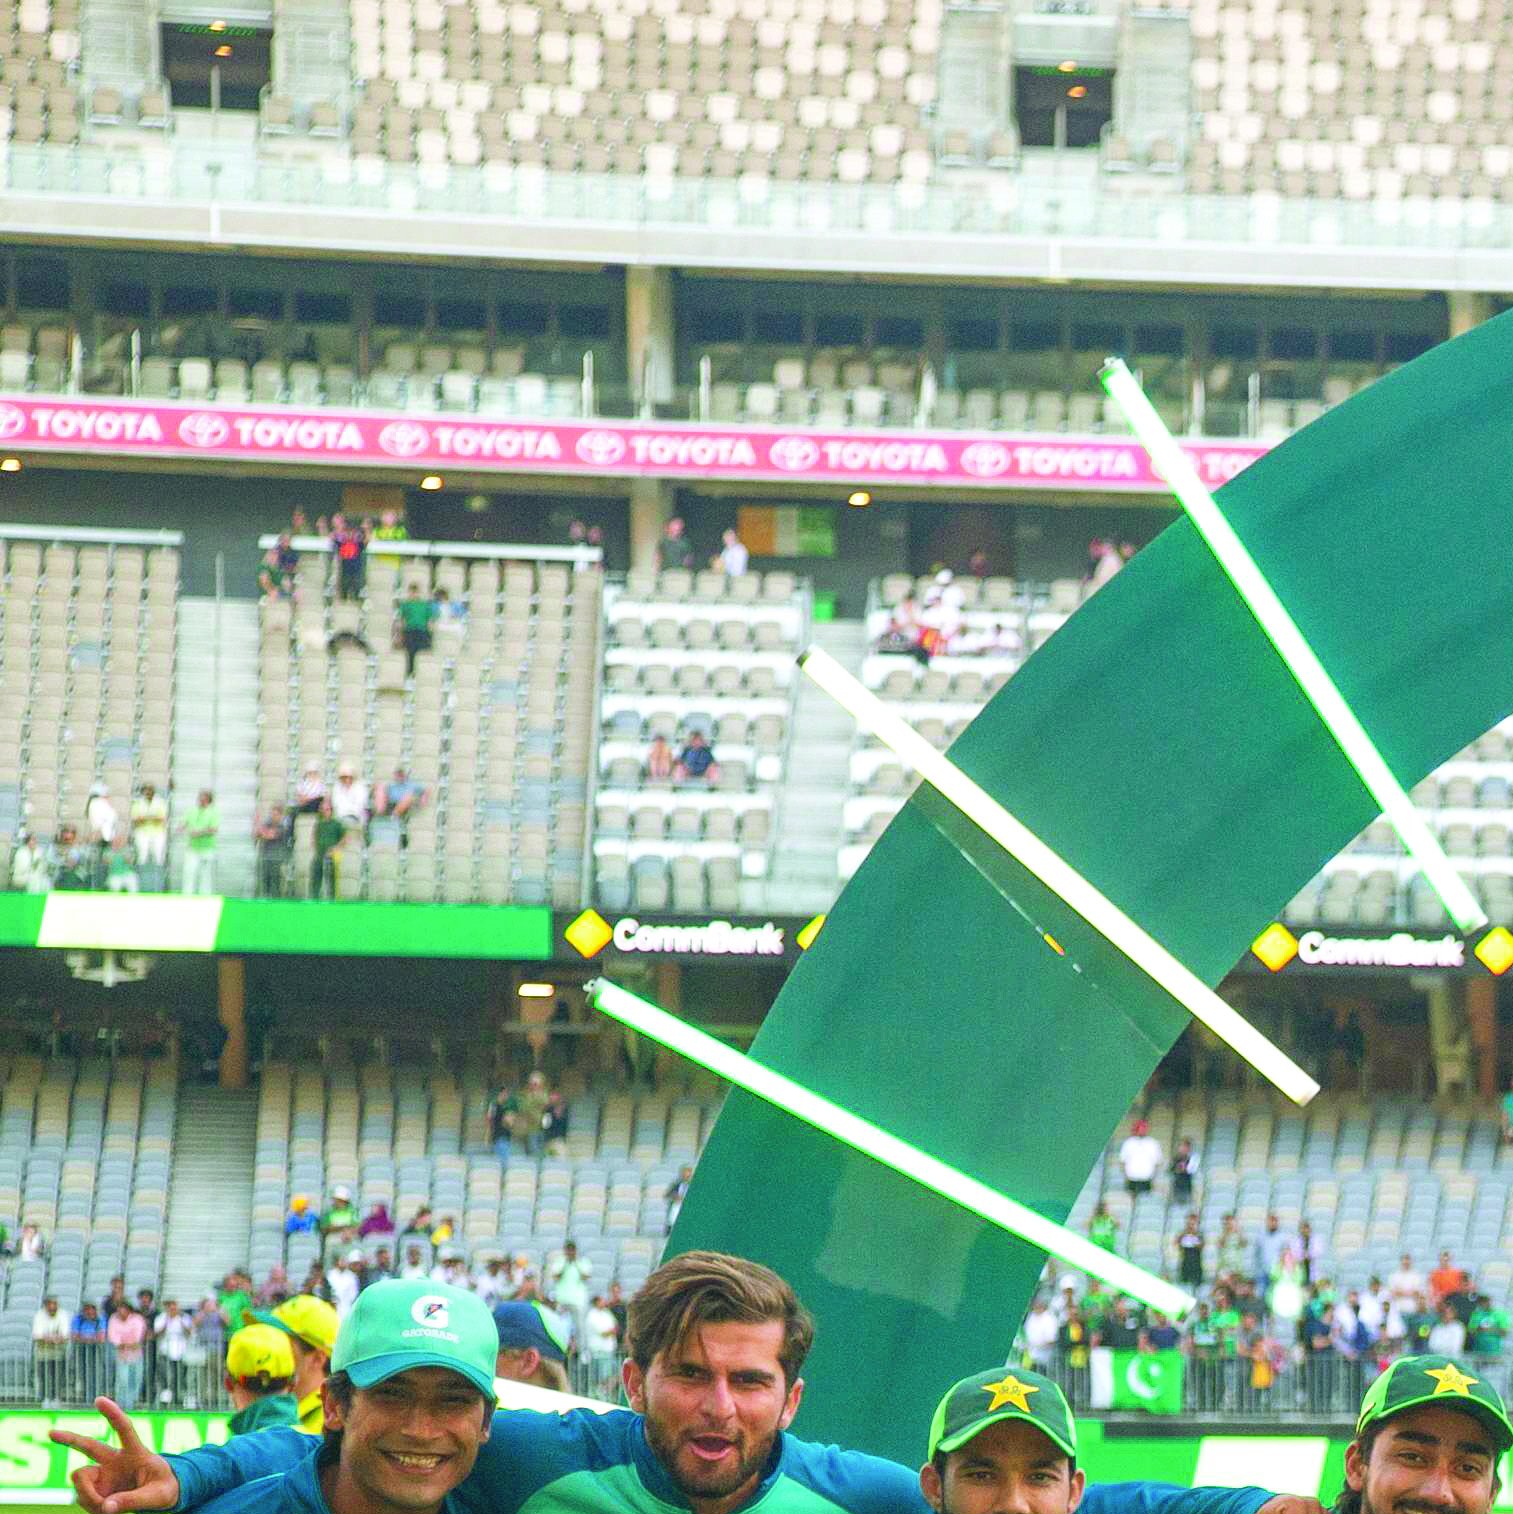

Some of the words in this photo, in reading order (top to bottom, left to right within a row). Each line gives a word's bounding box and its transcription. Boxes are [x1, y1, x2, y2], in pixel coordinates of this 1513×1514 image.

[32, 409, 163, 441] TOYOTA
[235, 420, 364, 452] TOYOTA
[433, 427, 562, 460] TOYOTA
[629, 435, 755, 466] TOYOTA
[822, 442, 948, 472] TOYOTA
[1012, 447, 1136, 477] TOYOTA
[614, 917, 783, 955] CommBank
